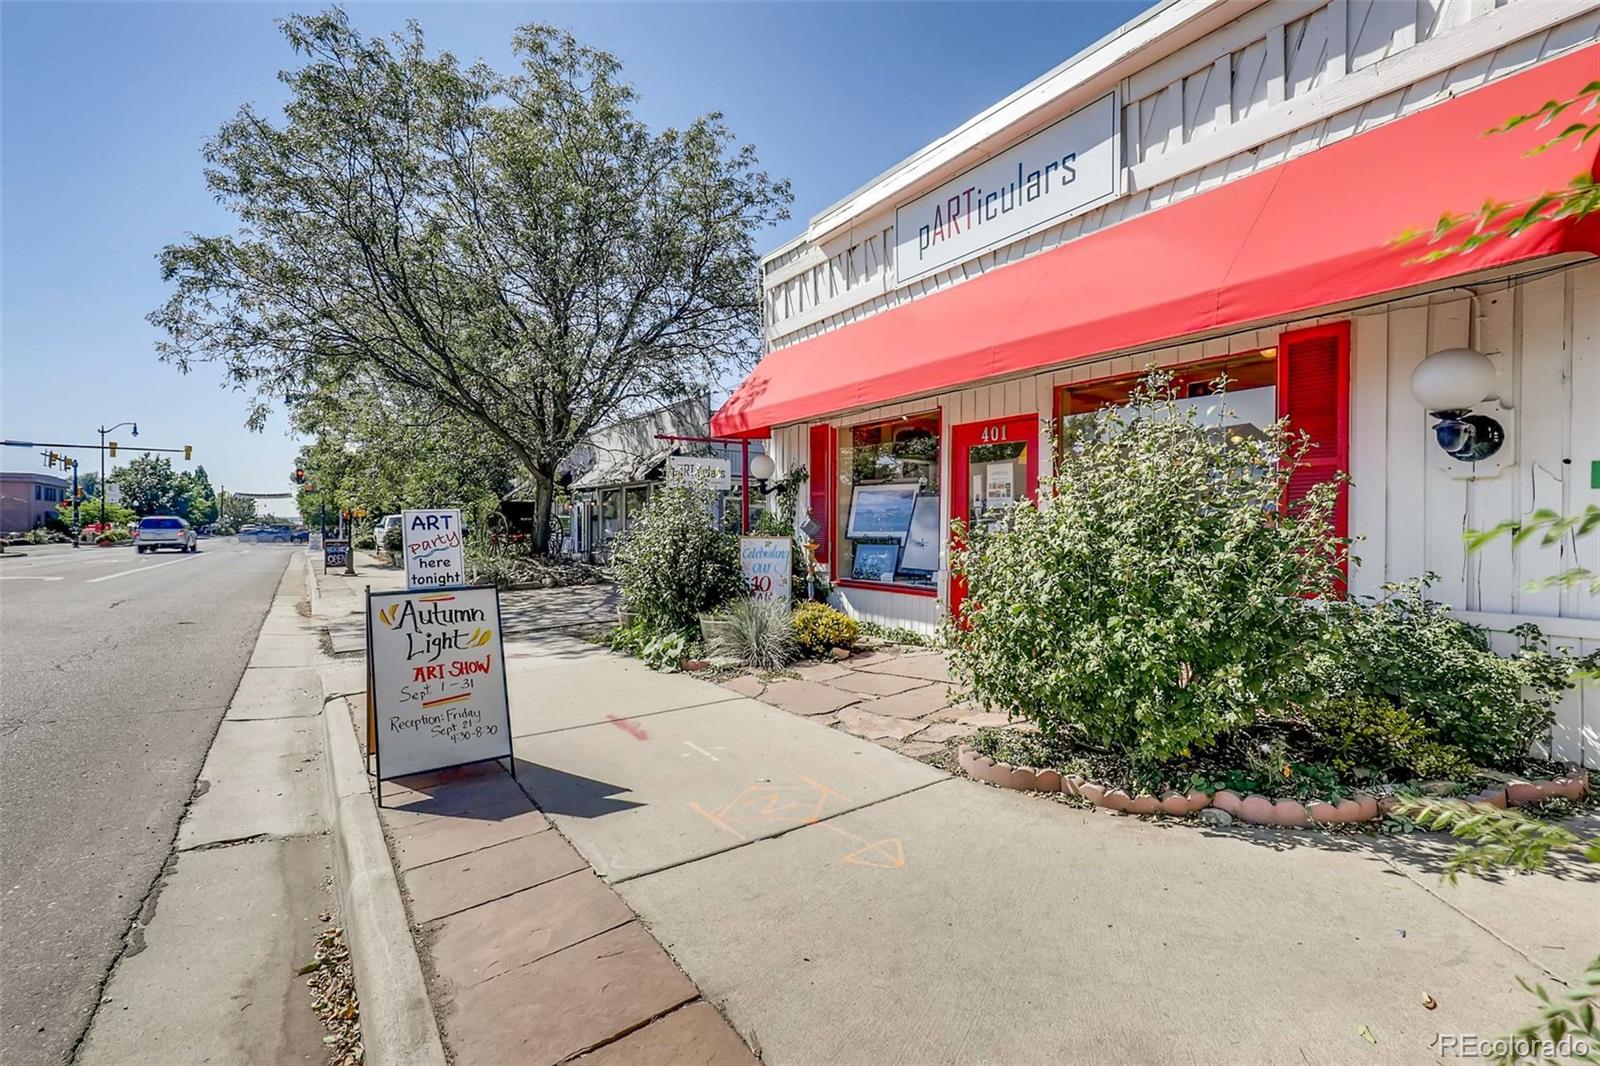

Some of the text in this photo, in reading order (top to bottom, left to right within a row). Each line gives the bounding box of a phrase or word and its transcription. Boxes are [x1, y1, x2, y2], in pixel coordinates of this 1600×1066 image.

[919, 152, 1077, 261] pARTiculars
[981, 424, 1008, 442] 401
[411, 515, 453, 530] ART
[419, 558, 451, 568] here
[411, 572, 461, 586] tonight
[751, 575, 772, 592] 10
[392, 600, 486, 633] Autumn
[406, 629, 470, 662] Light
[412, 654, 491, 682] ART SHOW
[389, 708, 482, 733] Reception: Friday
[431, 720, 473, 738] Sept 21
